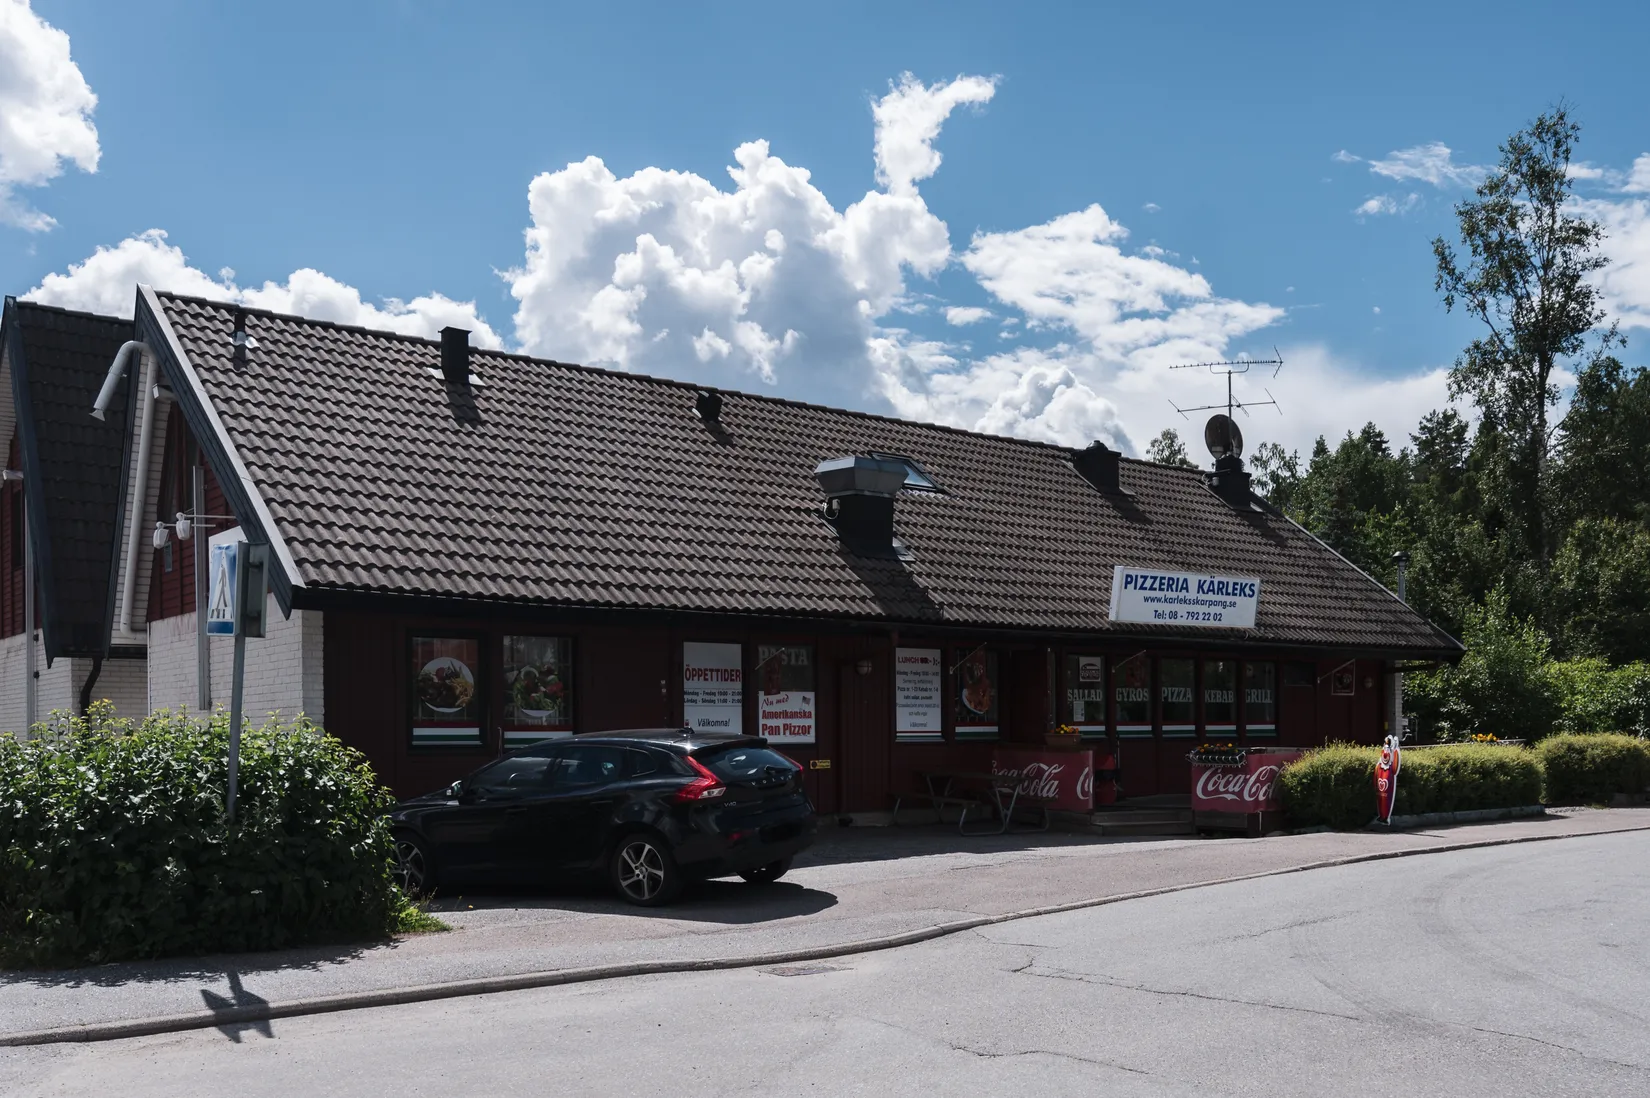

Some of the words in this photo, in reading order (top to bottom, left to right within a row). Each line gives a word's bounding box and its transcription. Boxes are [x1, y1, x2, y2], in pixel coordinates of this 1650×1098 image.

[1124, 574, 1189, 593] PIZZERIA
[1197, 576, 1255, 598] KÄRLEKS
[1143, 594, 1237, 609] www.karleksskarpang.se
[1153, 610, 1167, 620] Tel:
[1168, 611, 1178, 620] 08
[1186, 611, 1200, 621] 792
[1202, 612, 1211, 621] 22
[1213, 613, 1222, 621] 02
[685, 664, 741, 682] ÖPPETTIDER
[1067, 688, 1103, 701] SALLAD
[1116, 687, 1149, 702] GYROS
[1161, 687, 1193, 703] PIZZA
[1204, 689, 1234, 703] KEBAB
[1245, 688, 1273, 703] GRILL
[762, 709, 812, 719] Amerikanska
[697, 718, 731, 727] Välkomna!
[762, 723, 781, 736] Pan
[783, 723, 812, 736] Pizzor
[1196, 766, 1286, 801] Coca-Col
